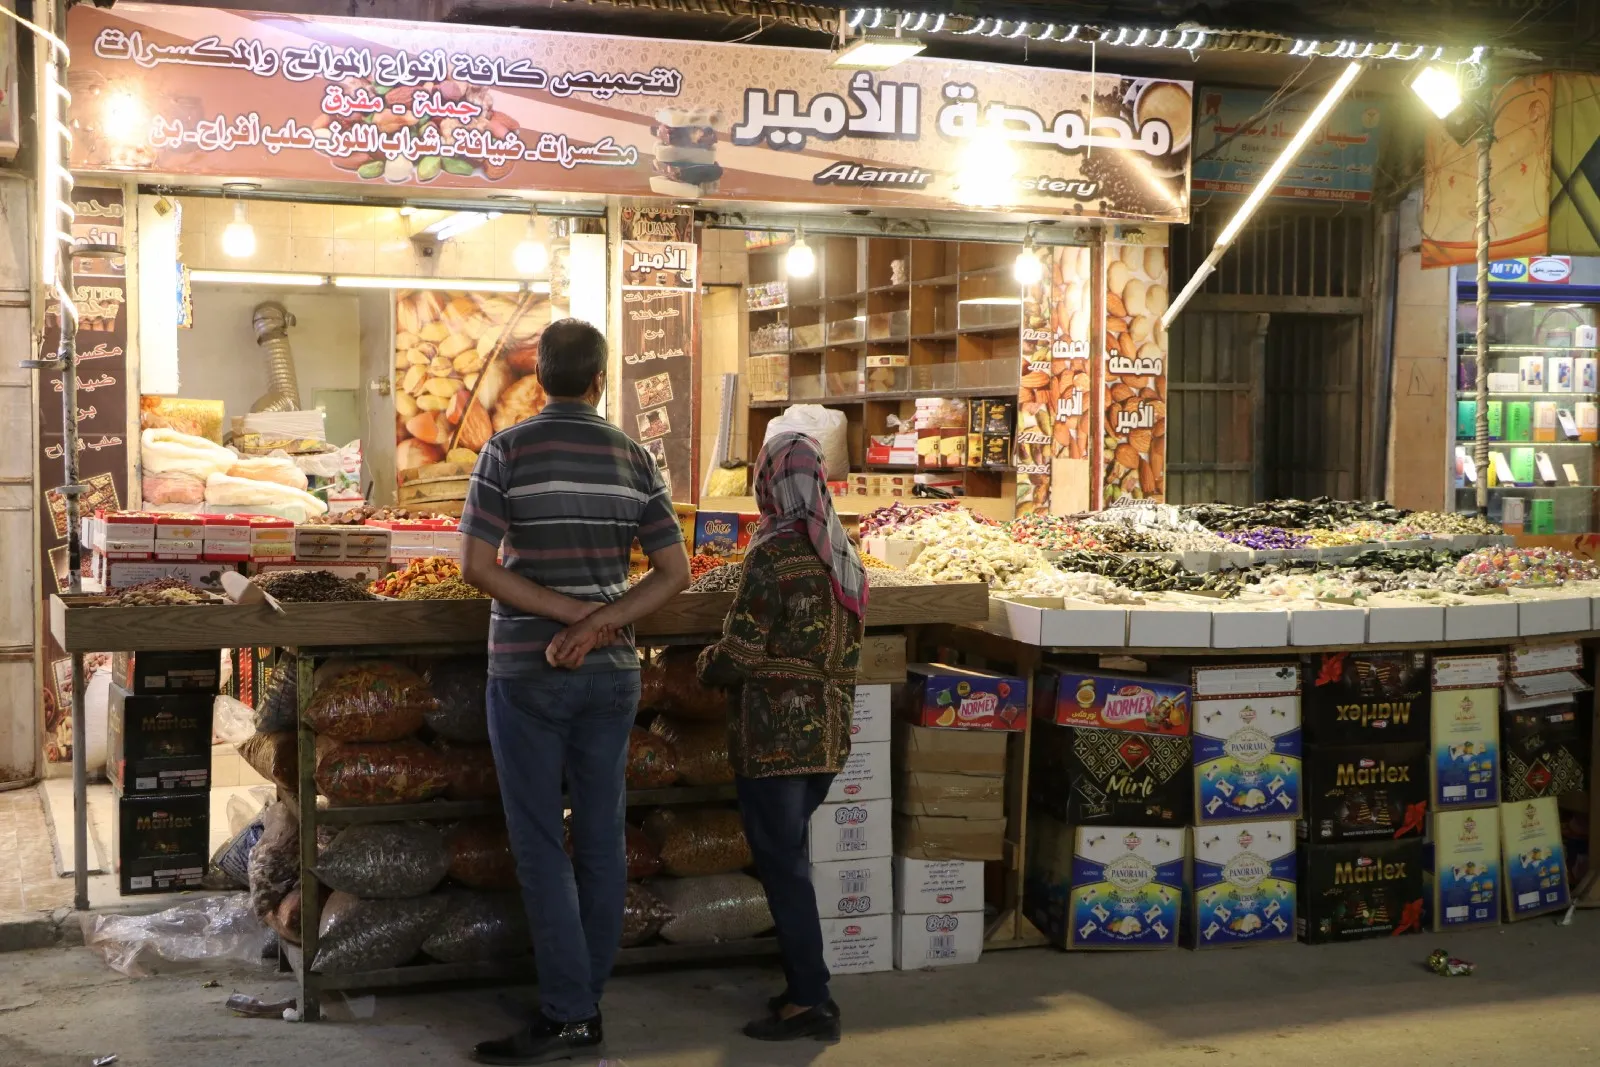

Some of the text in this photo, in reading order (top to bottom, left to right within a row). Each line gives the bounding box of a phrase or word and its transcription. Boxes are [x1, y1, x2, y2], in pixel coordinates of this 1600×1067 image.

[282, 44, 372, 82] الموالح
[375, 48, 447, 86] أنواع
[451, 55, 547, 89] كافة
[551, 67, 683, 99] لتحميص
[321, 84, 384, 117] مفرق
[412, 91, 482, 127] جملة
[731, 70, 1173, 157] محمصة الأمير
[815, 162, 933, 188] Alamir
[637, 221, 677, 236] JUAN
[630, 245, 687, 273] الأمير
[1491, 263, 1523, 274] MTN
[1109, 349, 1163, 376] محمصة
[1056, 387, 1083, 422] الأمير
[1116, 401, 1155, 434] الأمير
[961, 699, 996, 716] NORMEX
[1105, 696, 1154, 718] NORMEX
[1336, 702, 1411, 727] Marlex
[1231, 742, 1267, 752] PANORAMA
[1336, 760, 1411, 786] Marlex
[137, 812, 193, 832] Marlex
[1111, 869, 1149, 879] PANORAMA
[1228, 867, 1264, 878] PANORAMA
[1334, 858, 1407, 885] Marlex
[926, 914, 958, 932] Bako
